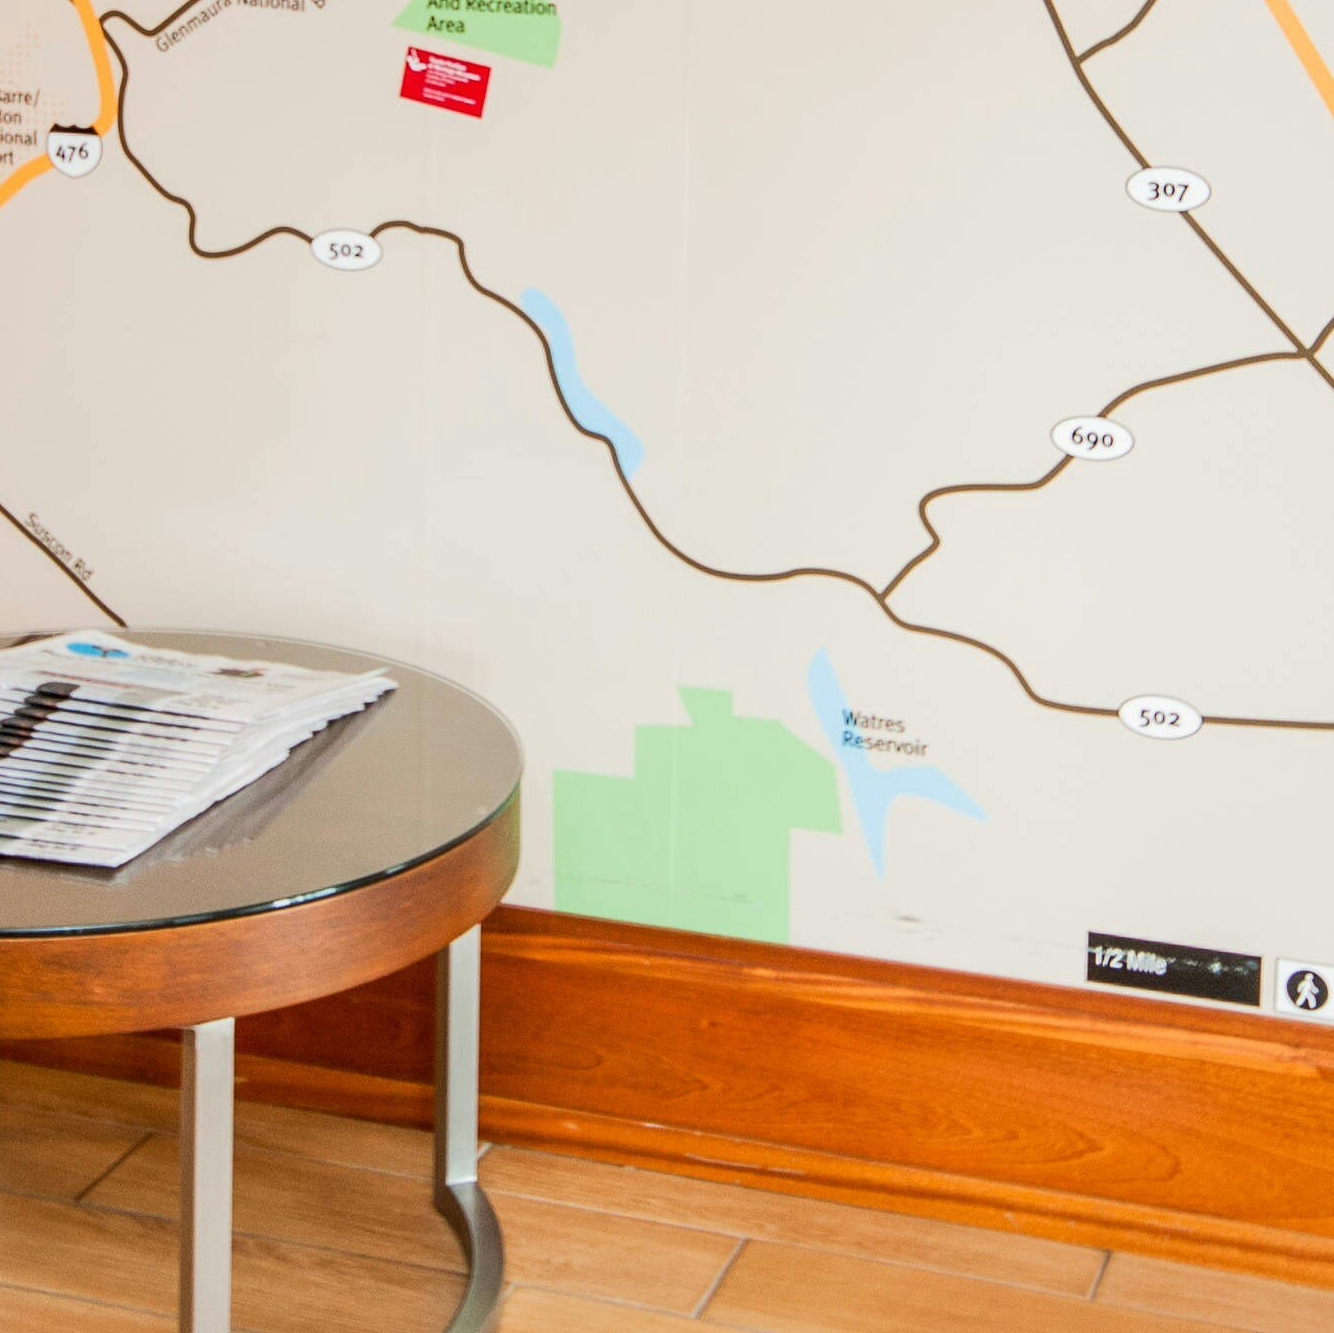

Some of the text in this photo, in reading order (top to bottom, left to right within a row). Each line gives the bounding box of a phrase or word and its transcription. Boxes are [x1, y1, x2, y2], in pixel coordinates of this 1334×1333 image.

[426, 16, 465, 33] Area
[56, 143, 89, 162] 476
[1146, 181, 1190, 203] 307
[329, 243, 364, 259] 502
[1070, 426, 1115, 450] 690
[24, 511, 95, 583] Suscon Rd
[841, 710, 906, 733] Watres
[1139, 709, 1180, 727] 502
[841, 732, 929, 757] Reservoir
[1092, 947, 1167, 976] 1/2 Mile
